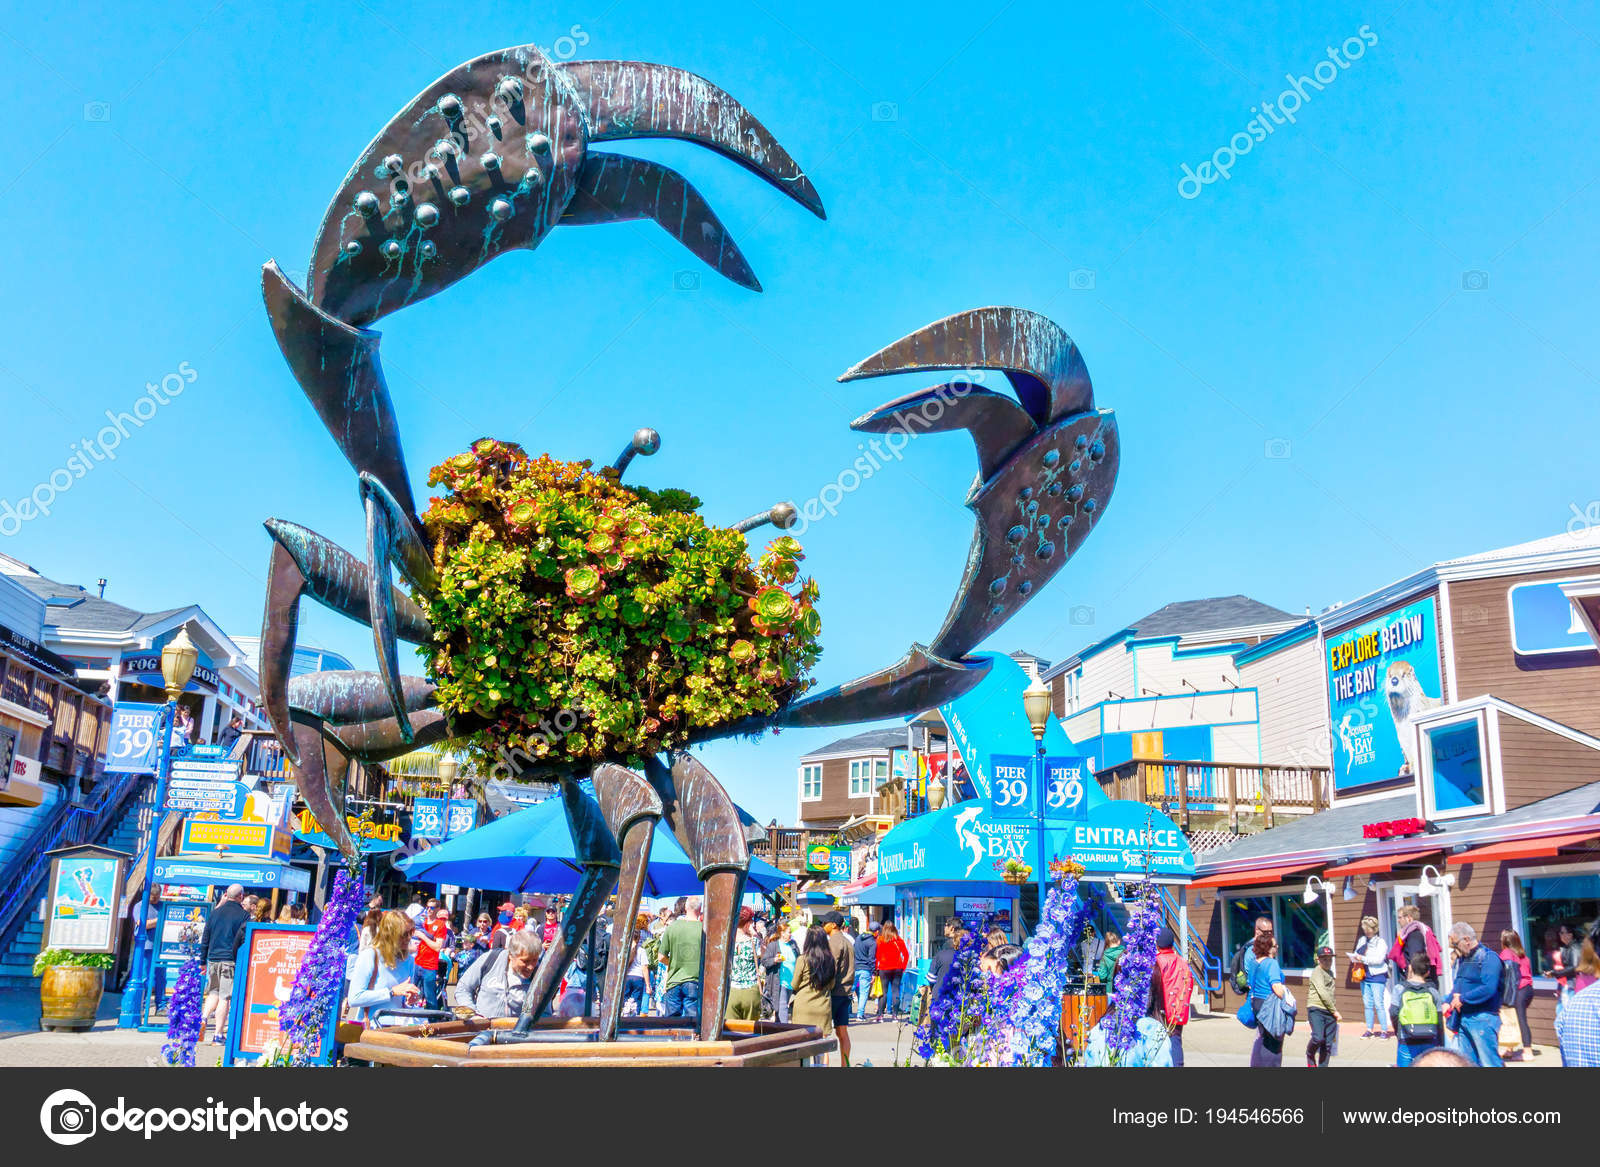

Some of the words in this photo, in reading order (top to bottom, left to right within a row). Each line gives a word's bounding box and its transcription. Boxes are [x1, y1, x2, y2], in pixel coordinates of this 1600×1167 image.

[1331, 631, 1380, 671] EXPLORE
[1381, 613, 1422, 653] BELOW
[127, 659, 158, 671] FOG
[1333, 673, 1354, 701] THE
[1354, 664, 1376, 695] BAY
[119, 714, 154, 728] PIER
[112, 728, 153, 758] 39
[1355, 736, 1373, 755] BAY
[995, 766, 1027, 779] PIER
[1050, 767, 1082, 780] PIER
[994, 779, 1028, 807] 39
[1048, 780, 1084, 808] 39
[417, 805, 438, 814] PIER
[415, 813, 439, 831] 39
[449, 814, 473, 832] 39
[972, 821, 1030, 837] AQUARIUM
[210, 834, 264, 842] INFORMATION
[1075, 826, 1178, 847] ENTRANCE
[988, 837, 1029, 858] BAY
[831, 862, 847, 875] 39
[879, 850, 904, 880] AQUARIUM
[913, 842, 926, 869] BAY
[1149, 855, 1184, 865] HEATER
